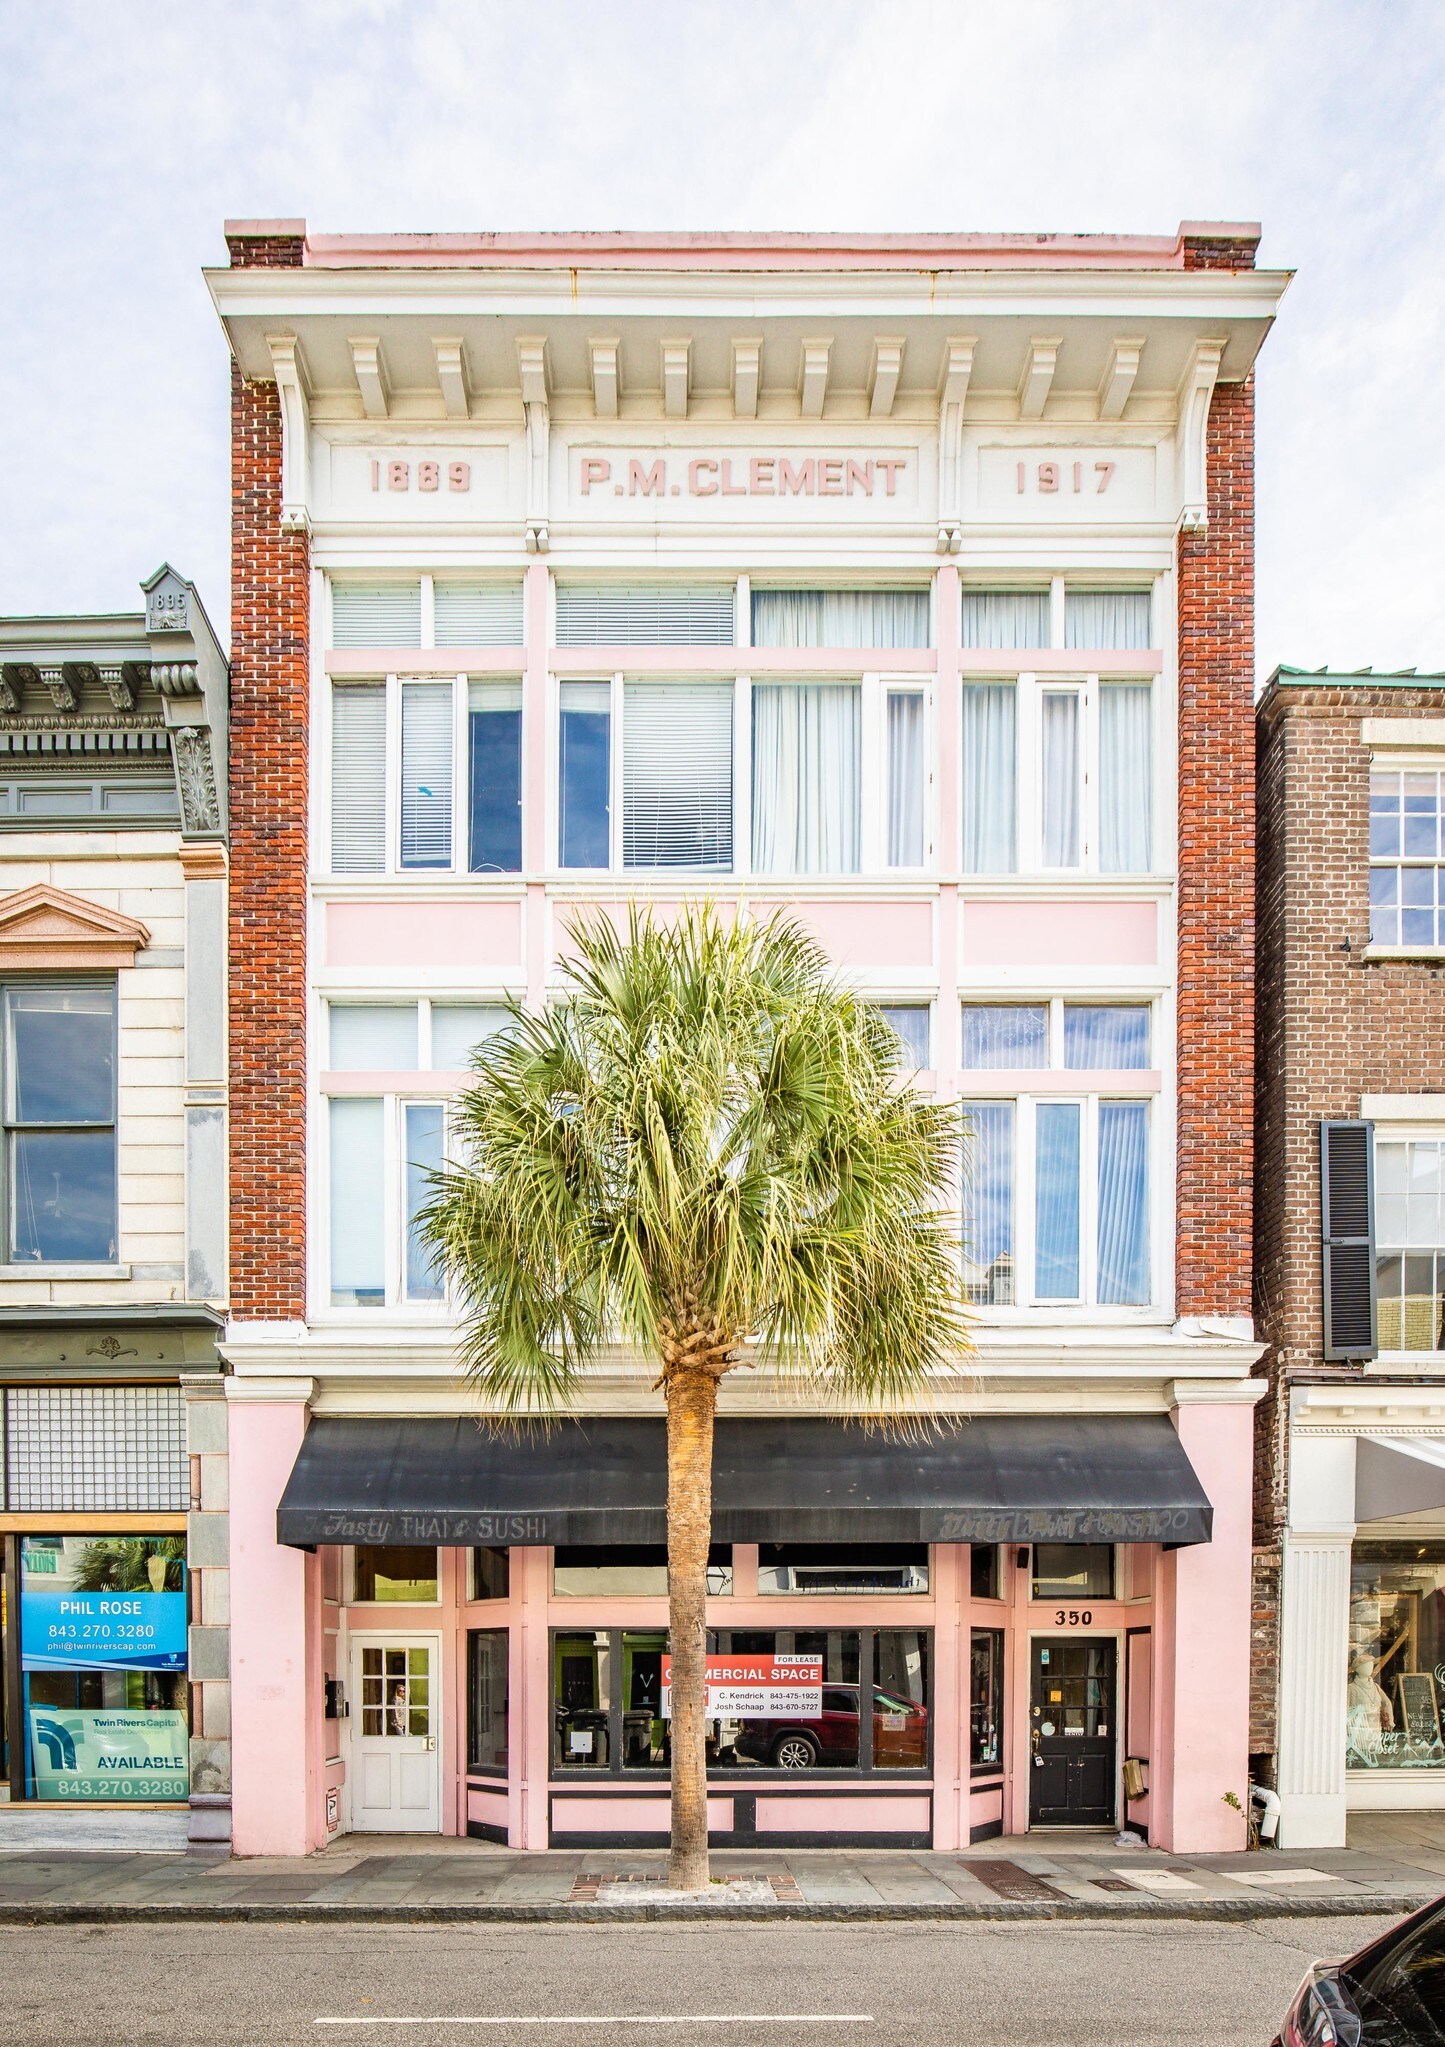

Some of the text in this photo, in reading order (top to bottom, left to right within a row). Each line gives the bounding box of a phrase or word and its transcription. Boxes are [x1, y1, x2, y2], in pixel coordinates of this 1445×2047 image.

[371, 460, 470, 492] 1889
[1017, 461, 1115, 494] 1917
[150, 593, 186, 609] 1895
[324, 1515, 391, 1543] Tasty
[400, 1517, 447, 1538] THAI
[478, 1517, 547, 1538] SUSHI
[60, 1601, 142, 1615] PHIL ROSE
[1055, 1610, 1092, 1626] 350
[49, 1624, 154, 1638] 843.270.3280
[47, 1642, 156, 1652] phil@twinriverscap.com
[771, 1668, 819, 1680] SPACE
[736, 1703, 764, 1712] Schaap
[146, 1719, 179, 1728] Capital
[97, 1757, 184, 1769] AVAILABLE
[58, 1781, 184, 1795] 843.270.3280
